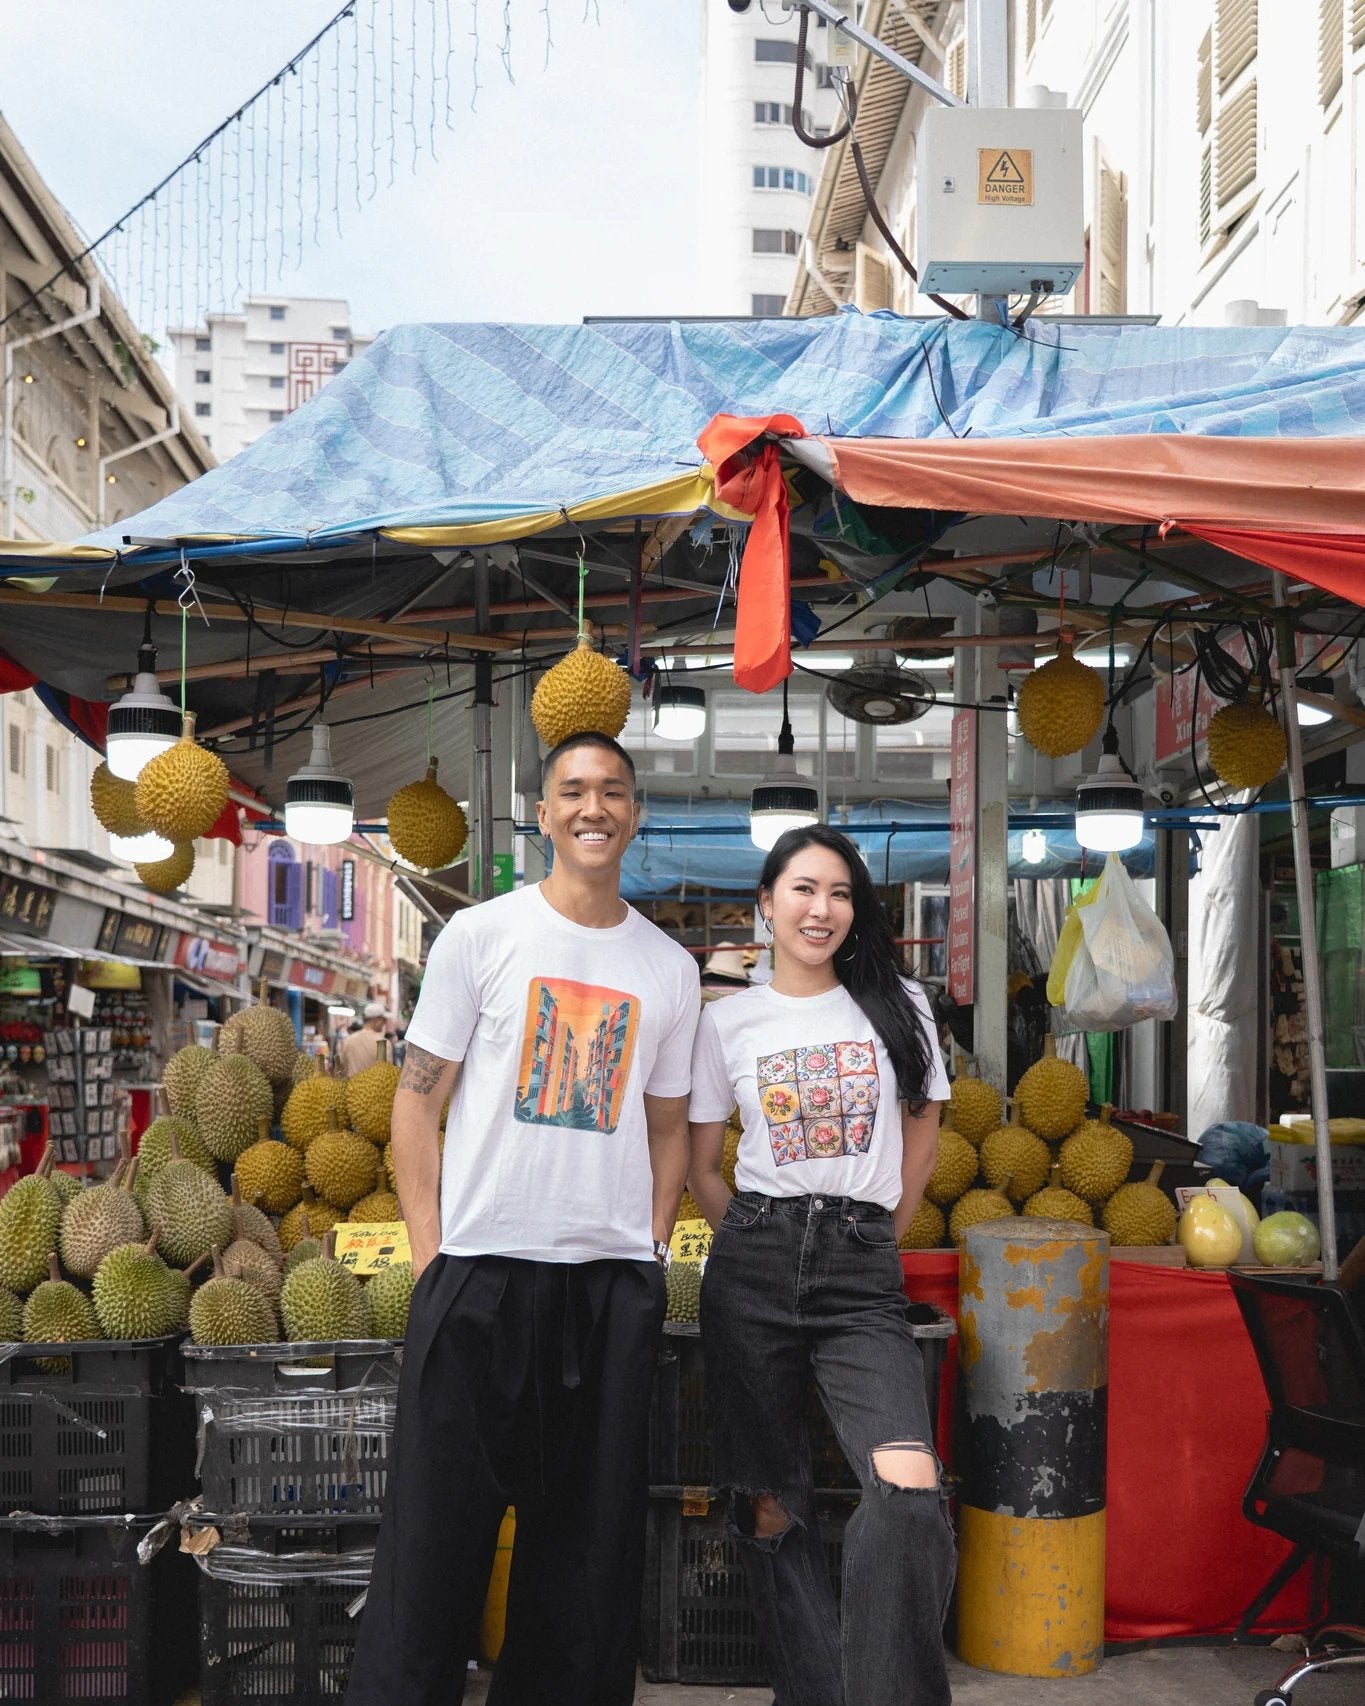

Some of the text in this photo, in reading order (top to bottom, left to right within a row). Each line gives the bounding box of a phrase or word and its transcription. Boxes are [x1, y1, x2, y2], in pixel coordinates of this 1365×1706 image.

[985, 184, 1025, 194] DANGER
[985, 195, 1025, 203] High Voltage
[953, 901, 969, 924] Packed
[953, 927, 969, 949] Durians
[953, 978, 967, 999] Travel
[680, 1232, 708, 1241] BLACK
[679, 1241, 711, 1258] 黑刺
